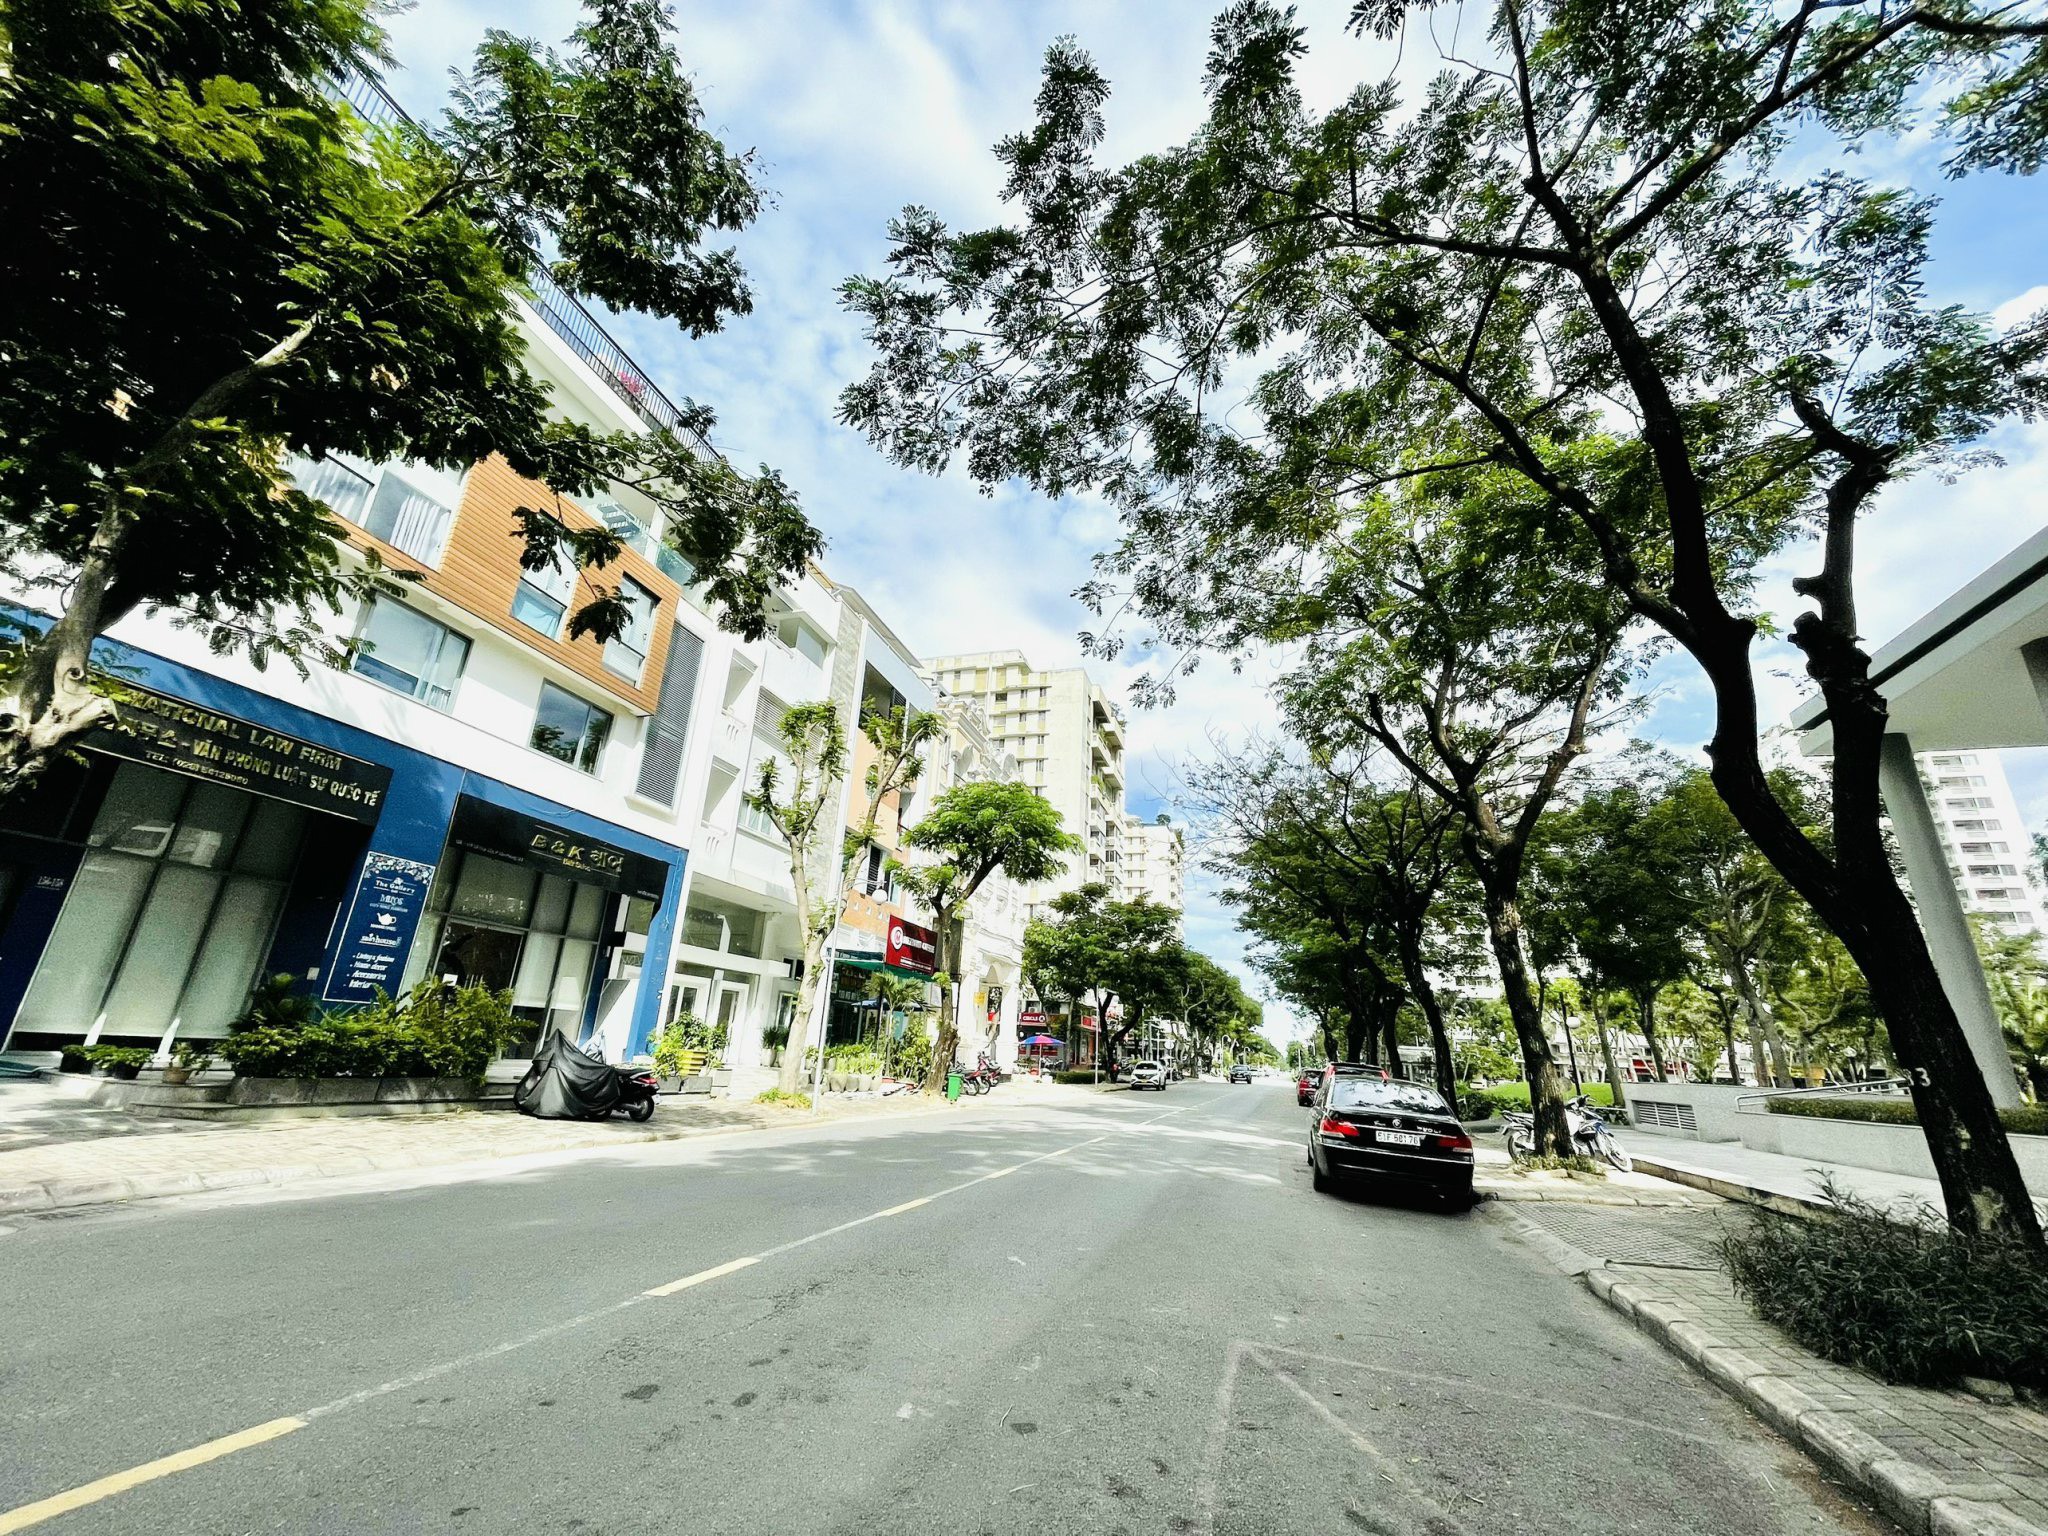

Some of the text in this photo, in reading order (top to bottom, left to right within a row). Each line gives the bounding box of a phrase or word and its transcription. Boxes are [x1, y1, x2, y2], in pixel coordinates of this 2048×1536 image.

[249, 729, 294, 755] LAW
[298, 746, 342, 770] FIRM
[193, 738, 223, 760] VĂN
[224, 749, 271, 775] PHÒNG
[273, 764, 308, 786] LUẬT
[309, 774, 329, 791] SƯ
[330, 781, 362, 801] QUỐC
[363, 789, 381, 806] TẾ
[375, 879, 415, 894] The Gallery
